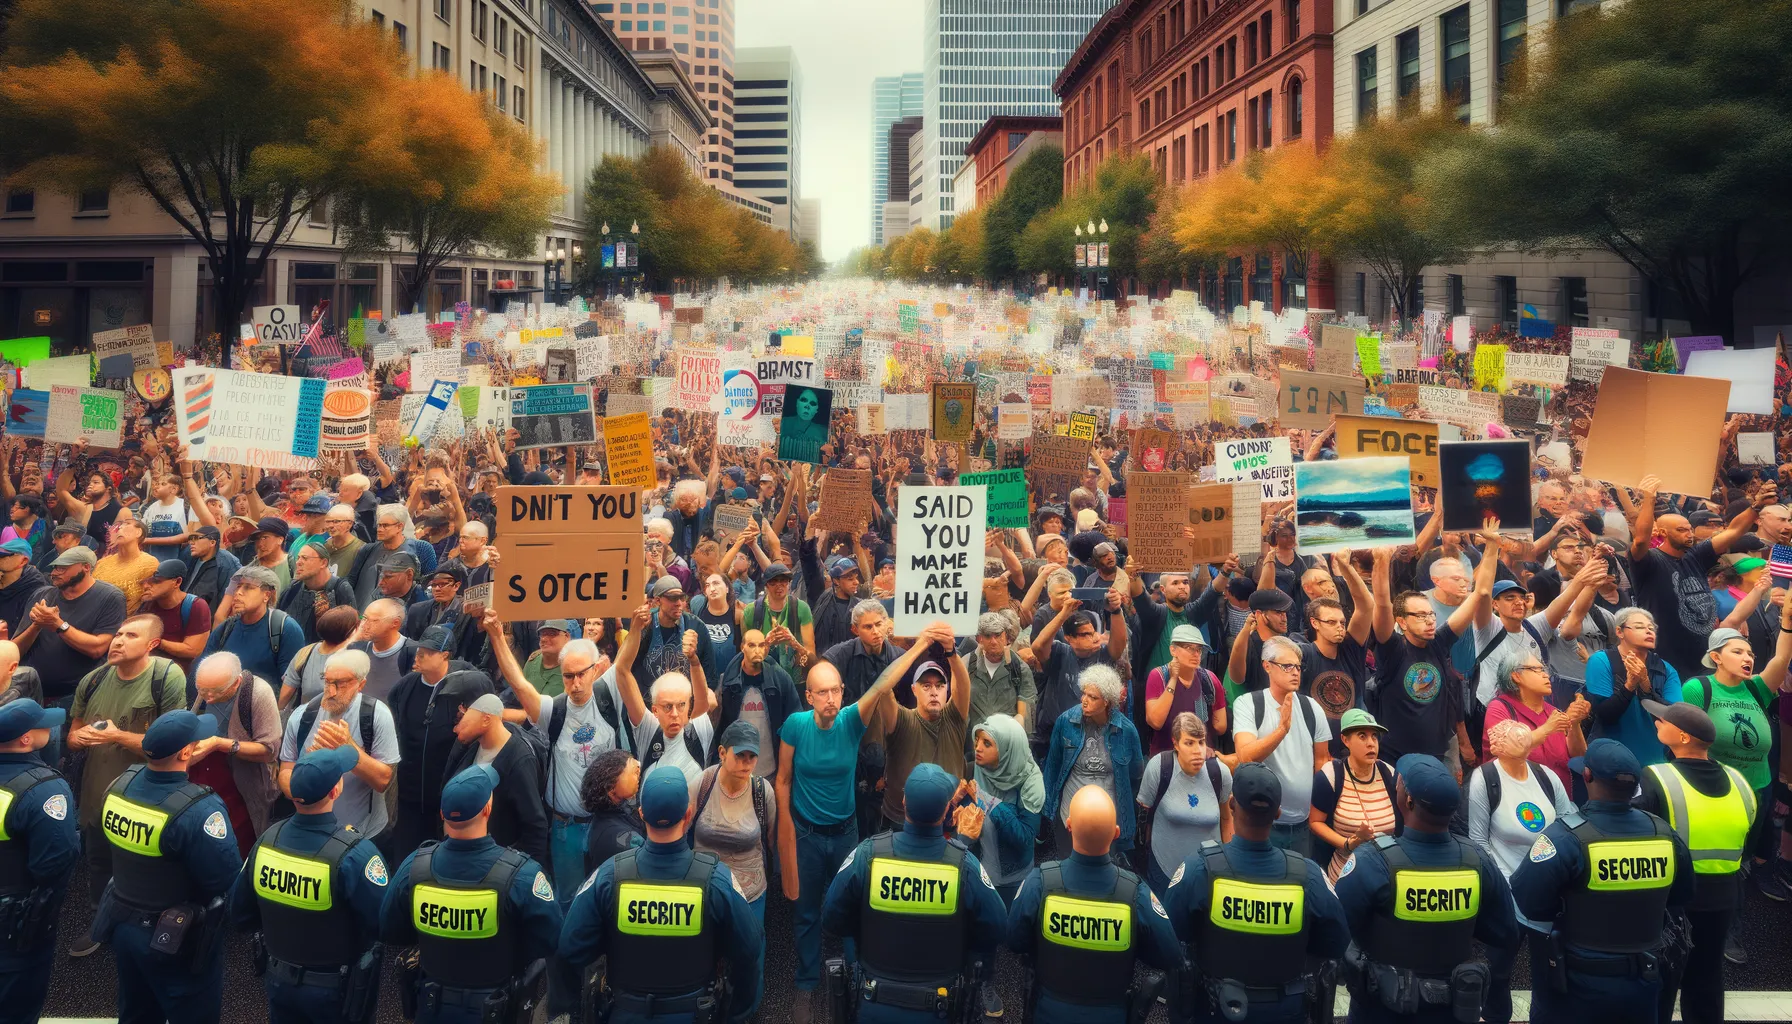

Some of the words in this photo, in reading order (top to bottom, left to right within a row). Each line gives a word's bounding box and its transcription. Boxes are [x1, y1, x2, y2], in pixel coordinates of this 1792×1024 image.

[587, 492, 636, 520] YOU
[913, 495, 973, 518] SAID
[921, 523, 971, 549] YOU
[911, 552, 968, 571] MAME
[904, 591, 968, 615] HACH
[880, 876, 949, 904] SECRITY
[420, 902, 488, 931] SECUITY
